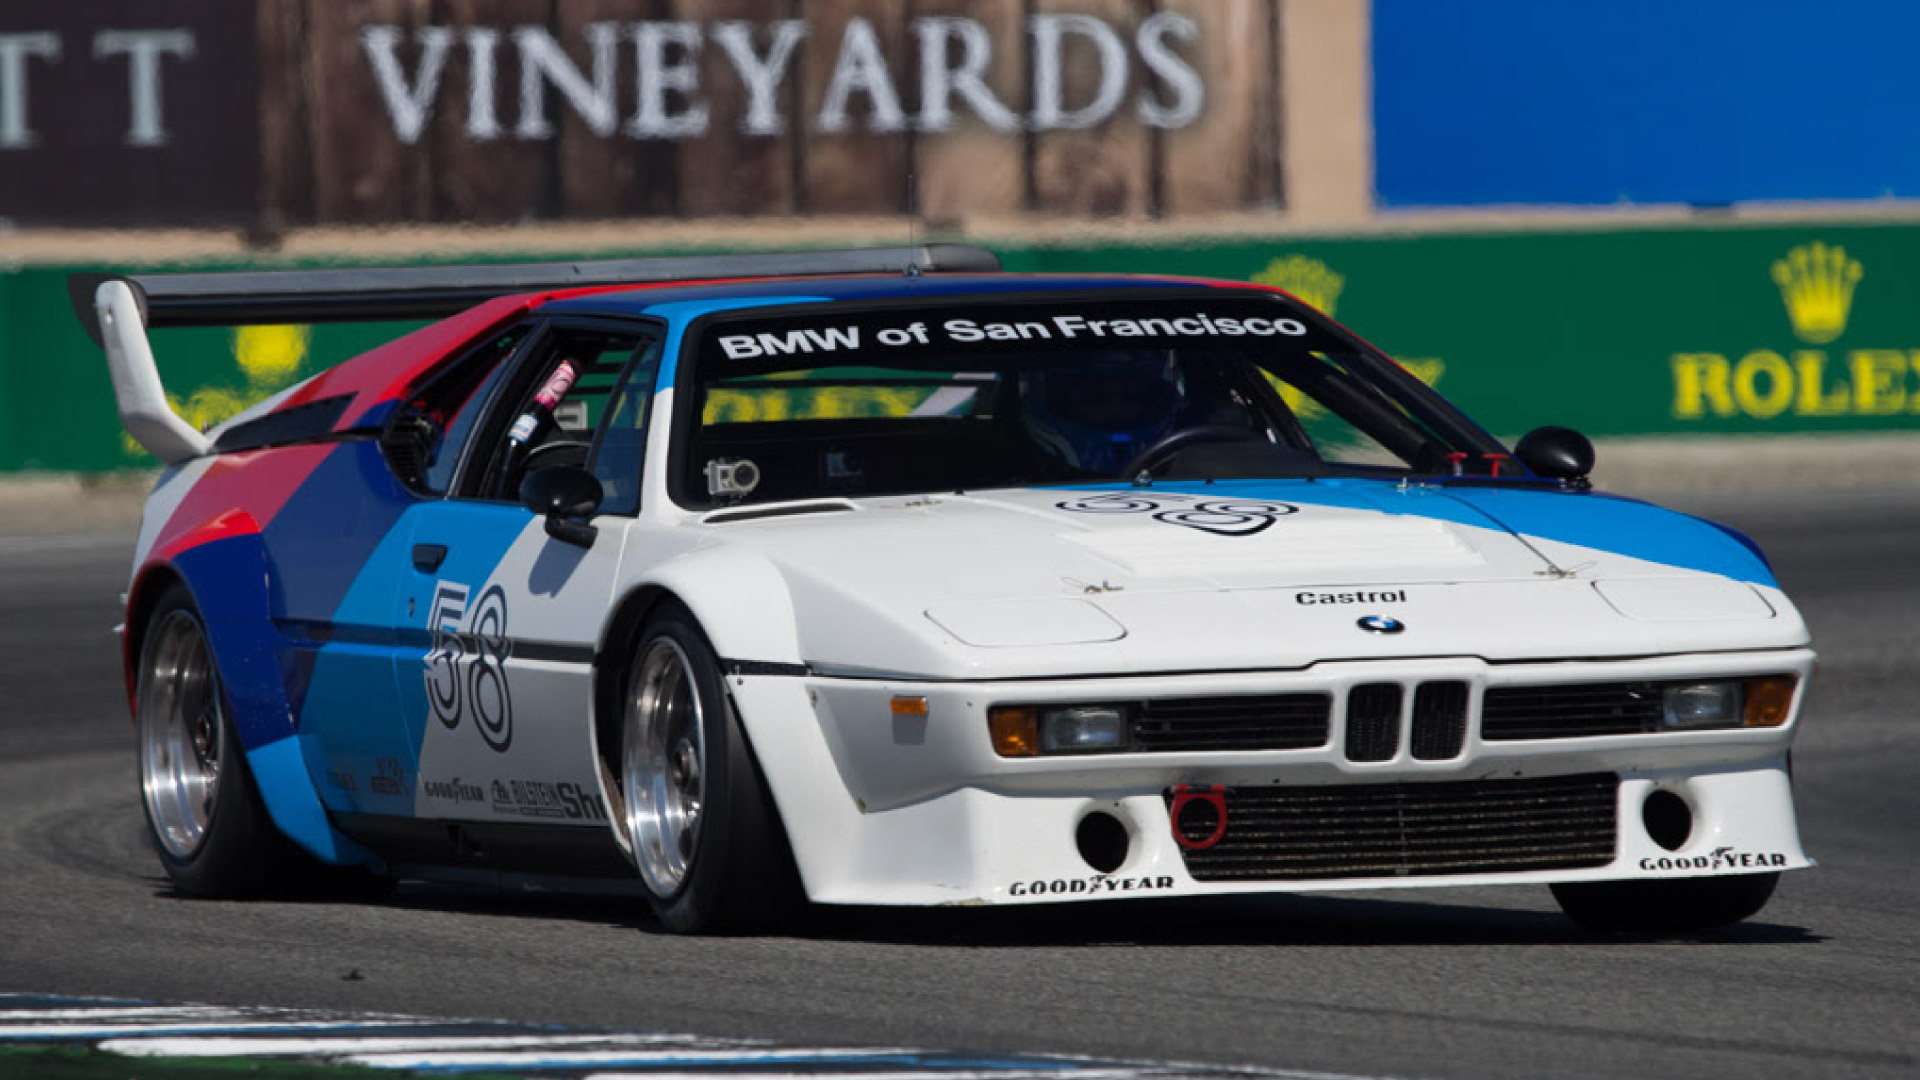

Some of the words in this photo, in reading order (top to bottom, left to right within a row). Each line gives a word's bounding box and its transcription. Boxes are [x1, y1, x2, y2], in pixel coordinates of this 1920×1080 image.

[361, 14, 1206, 143] VINEYARDS
[718, 326, 860, 360] BMW
[877, 322, 929, 345] of
[944, 319, 1052, 342] San
[1052, 313, 1307, 339] Francisco
[1295, 590, 1407, 605] Castrol
[424, 579, 513, 753] 58
